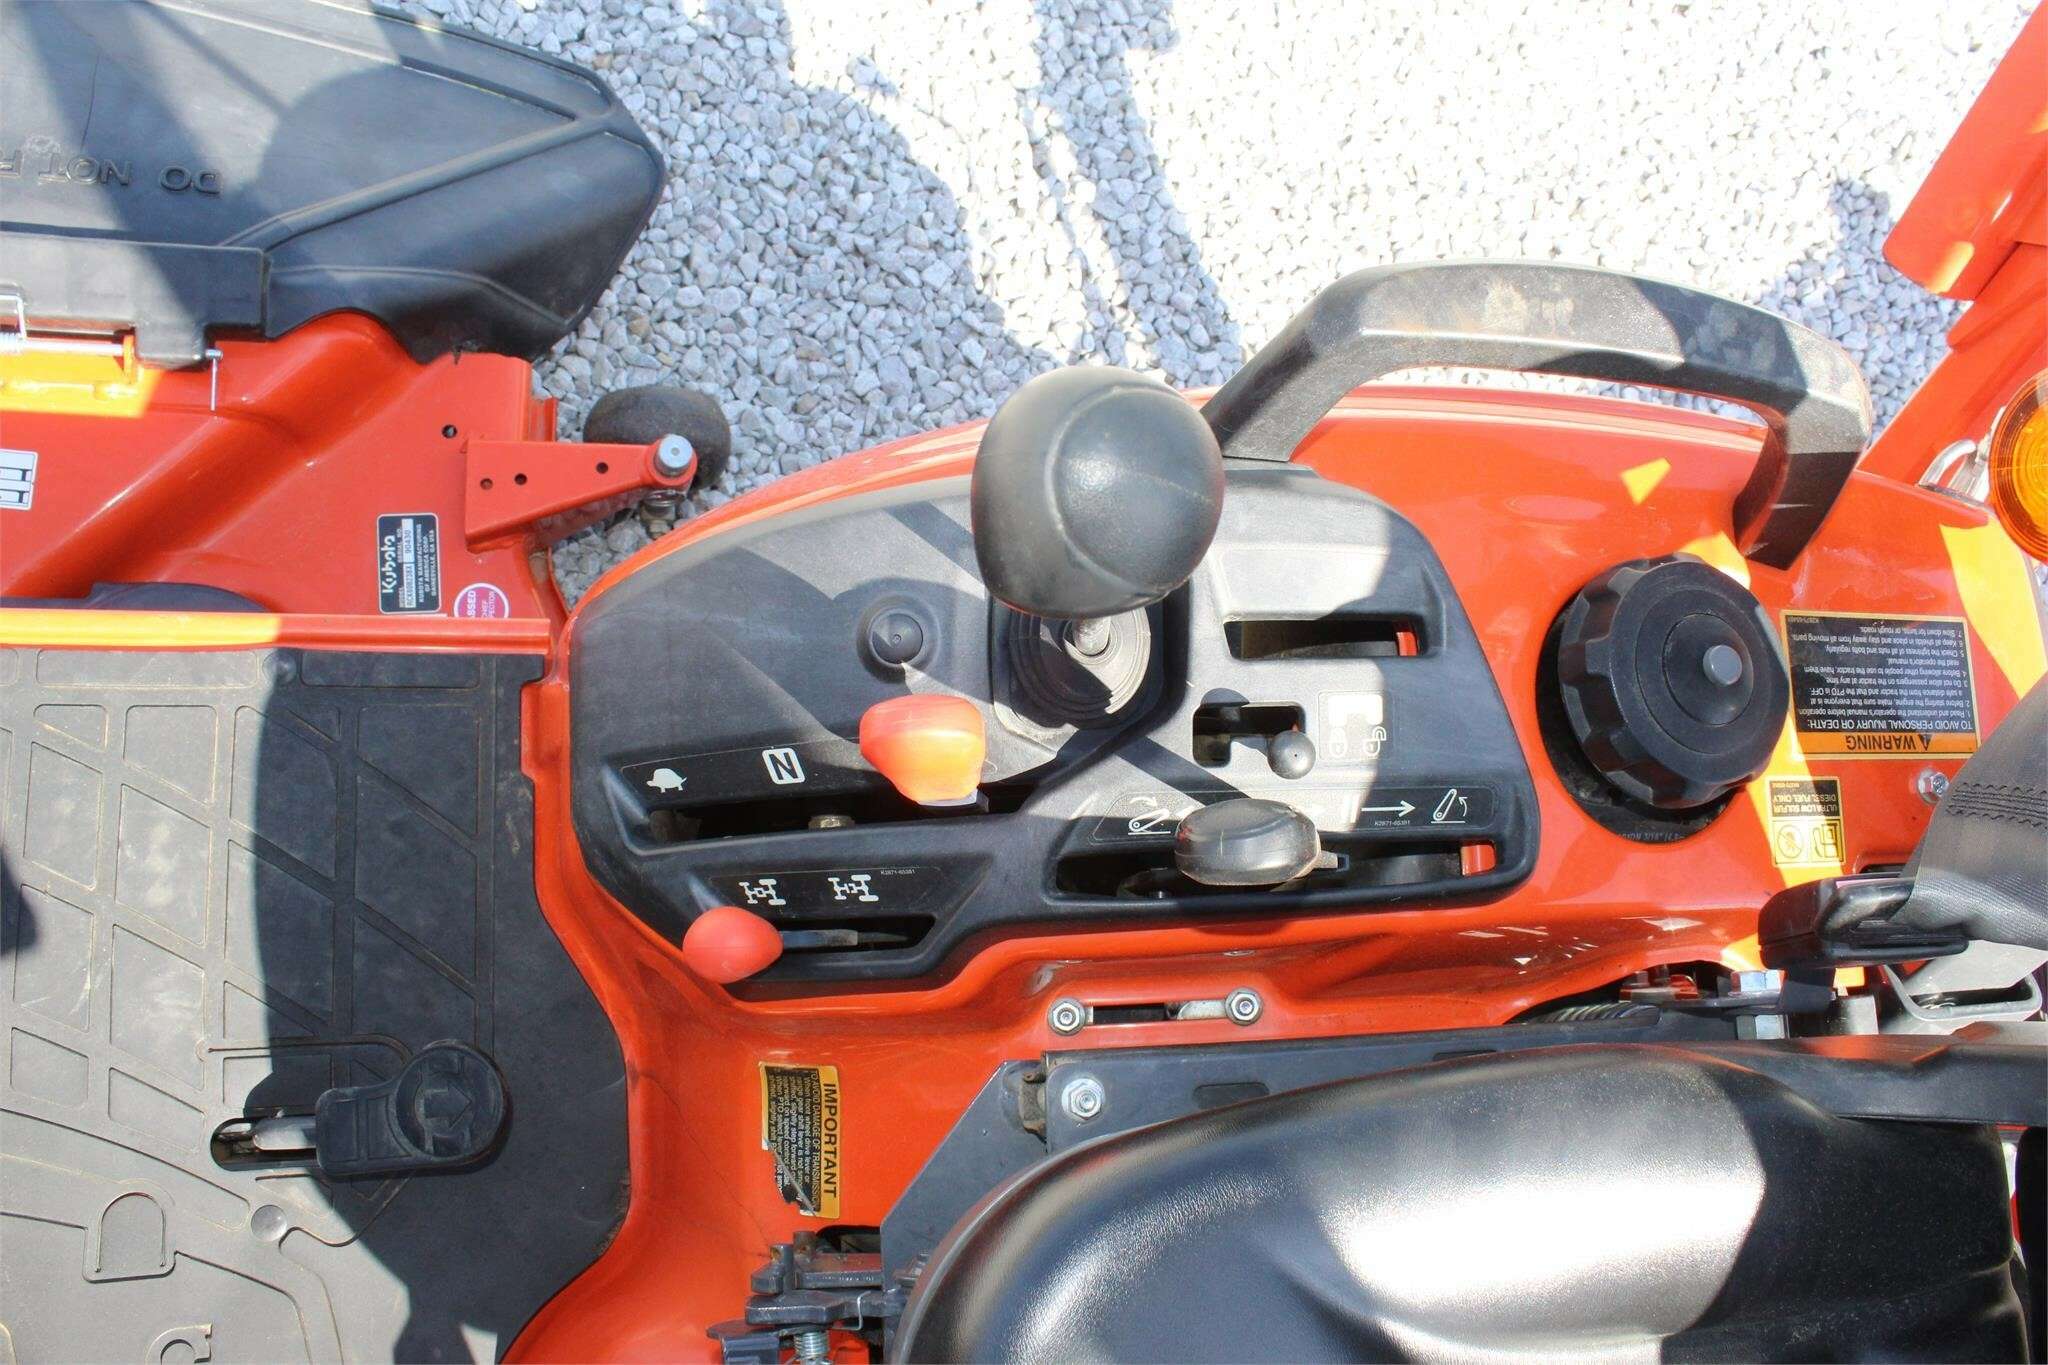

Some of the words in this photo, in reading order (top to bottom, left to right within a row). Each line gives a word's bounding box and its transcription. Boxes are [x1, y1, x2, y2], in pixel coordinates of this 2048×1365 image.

[38, 151, 130, 187] NOT
[160, 166, 220, 197] DO
[381, 535, 397, 593] Kubota
[1808, 719, 1839, 729] DEATH:
[1841, 719, 1854, 729] OR
[1857, 719, 1886, 729] INJURY
[1889, 720, 1933, 729] PERSONAL
[1935, 720, 1960, 729] AVOID
[1960, 720, 1972, 729] TO
[1845, 735, 1916, 751] WARNING
[768, 752, 799, 780] N
[1773, 794, 1791, 802] ONLY
[1773, 805, 1800, 813] SULFUR
[1801, 804, 1816, 812] LOW
[812, 1139, 820, 1150] OF
[823, 1083, 837, 1198] IMPORTANT
